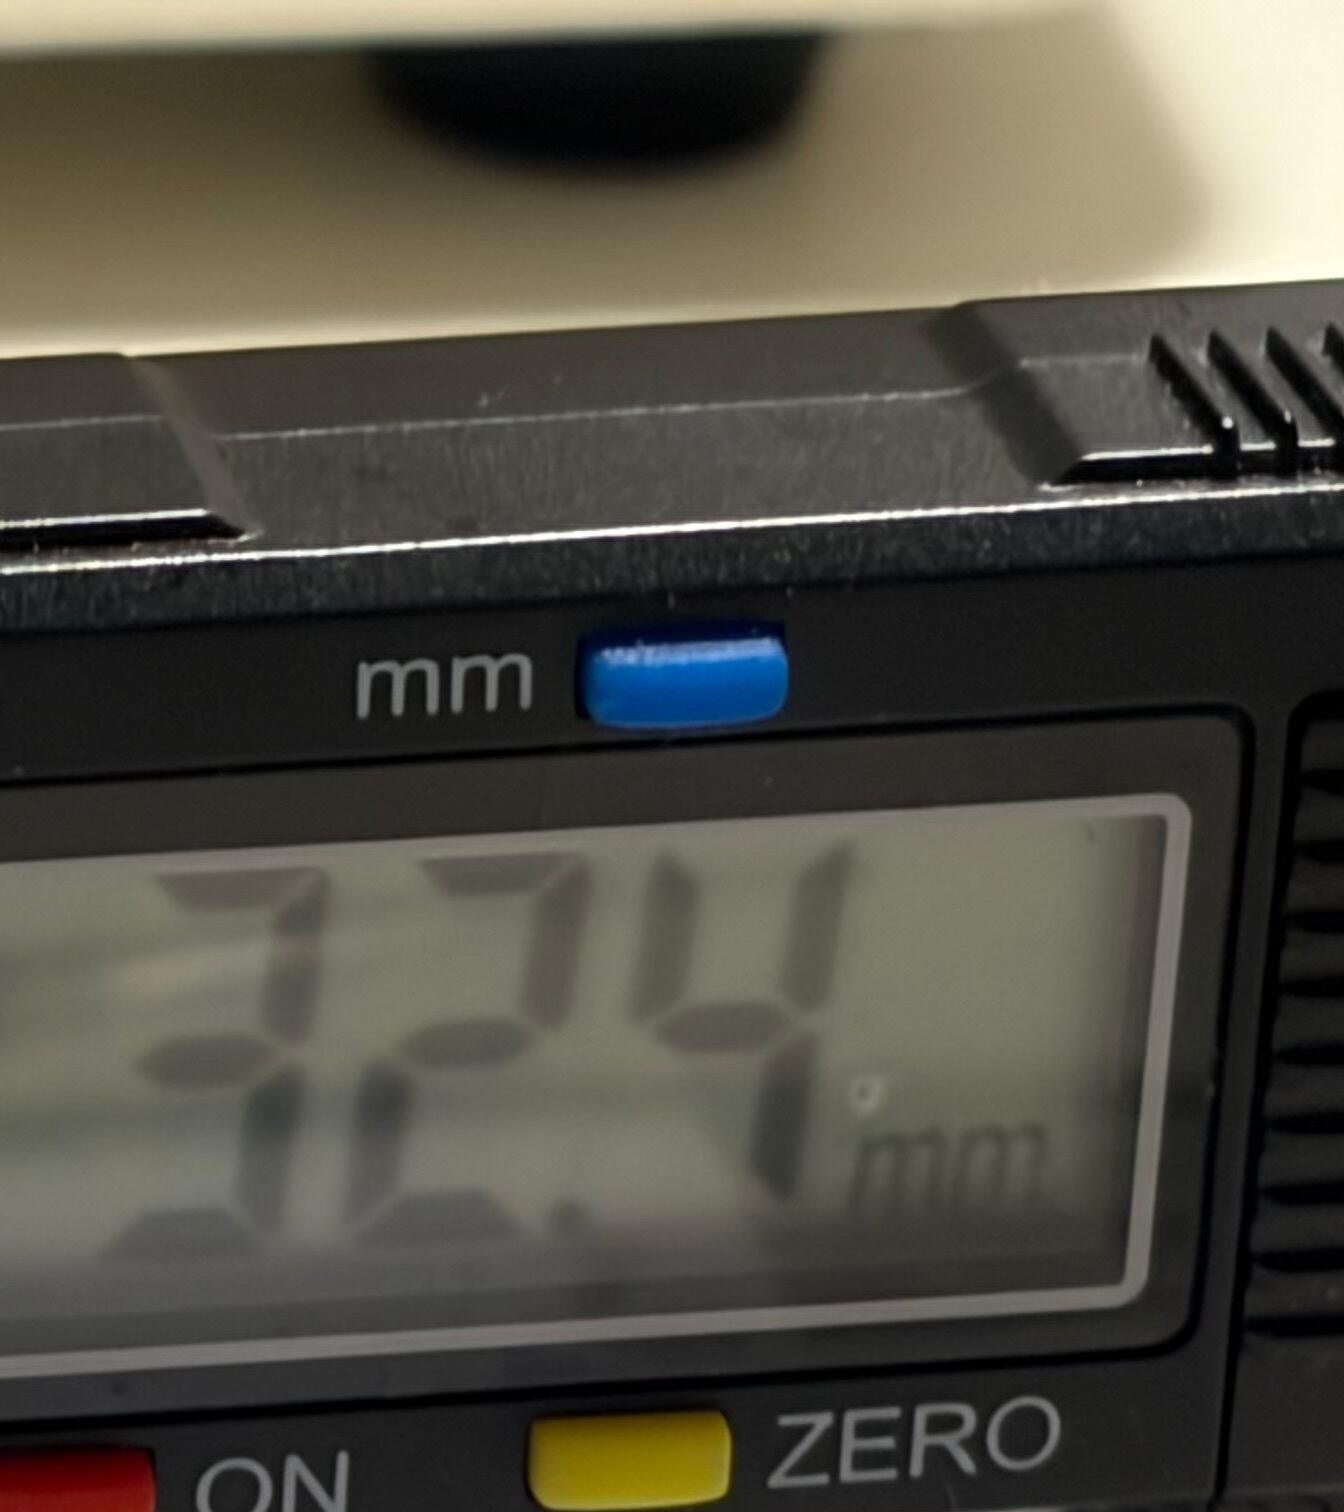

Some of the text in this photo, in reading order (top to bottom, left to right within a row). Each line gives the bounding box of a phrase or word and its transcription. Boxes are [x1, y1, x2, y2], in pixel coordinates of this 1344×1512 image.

[356, 652, 533, 720] mm
[845, 1122, 1047, 1220] mm
[765, 1395, 1064, 1491] ZERO
